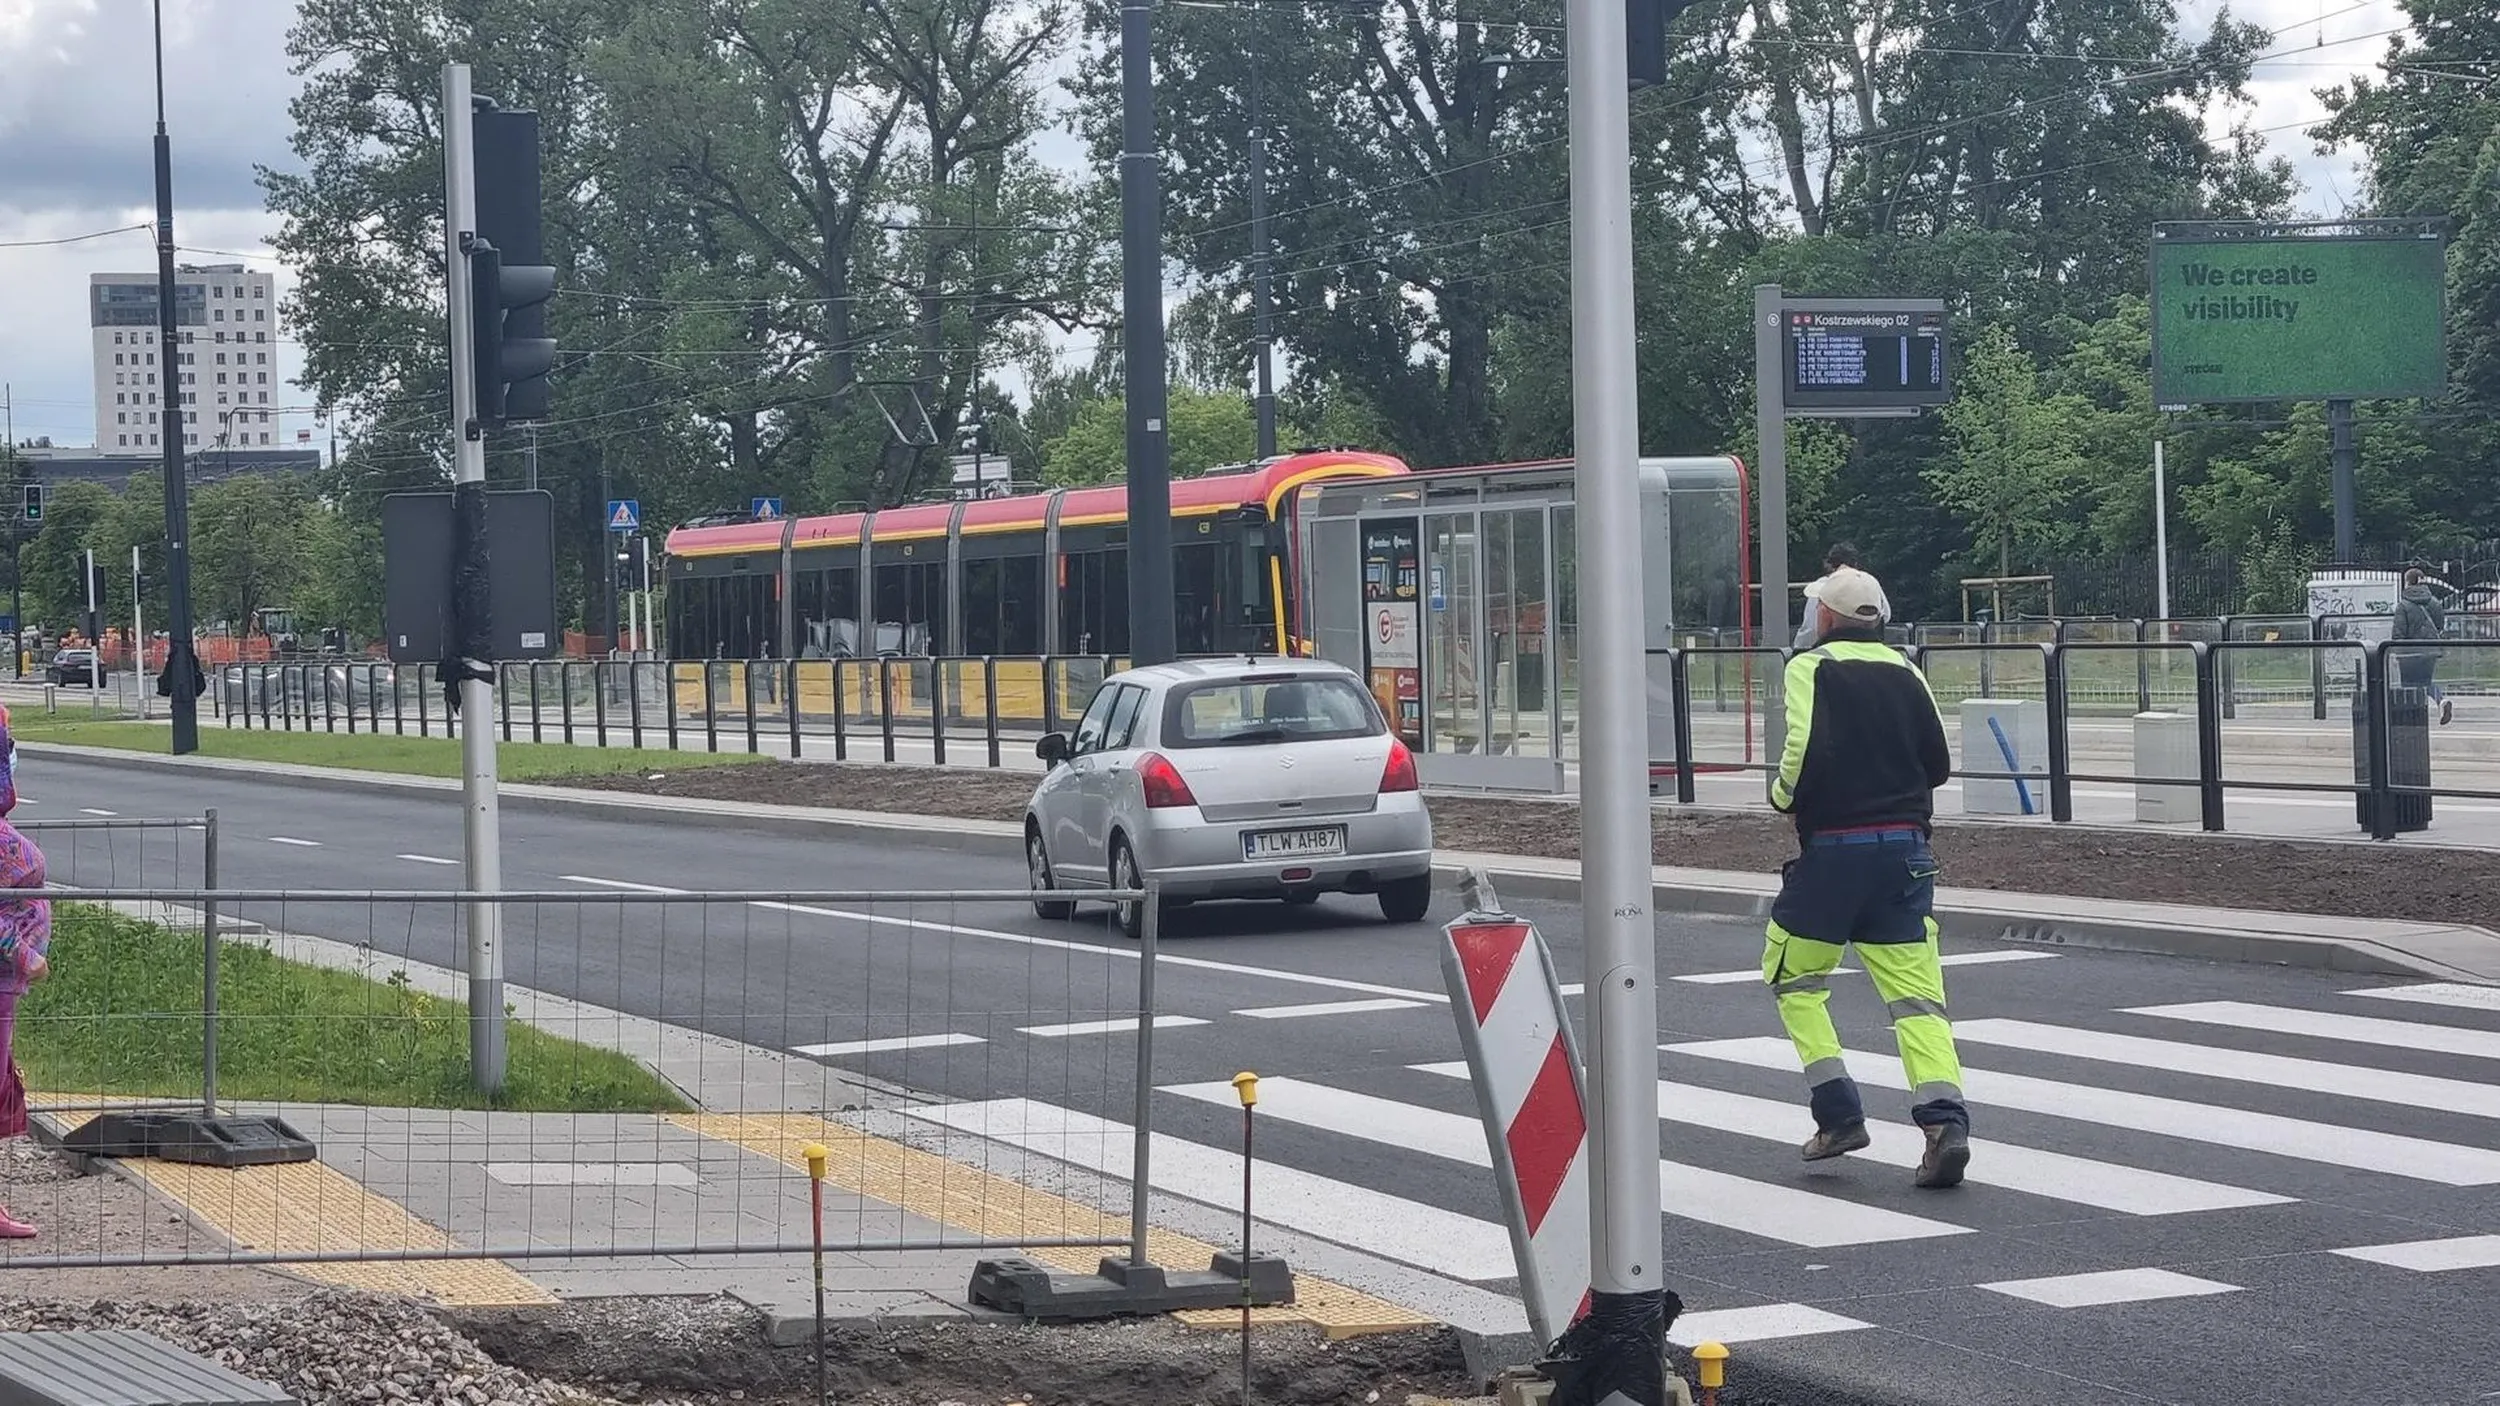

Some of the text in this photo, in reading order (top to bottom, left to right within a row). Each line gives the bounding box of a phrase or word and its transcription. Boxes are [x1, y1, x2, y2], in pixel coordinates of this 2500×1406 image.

[2182, 264, 2318, 287] We create
[2182, 295, 2300, 323] visibility
[1814, 315, 1894, 328] Kostrzewskiego
[1896, 314, 1910, 326] 02
[1257, 830, 1337, 851] TLW AH87
